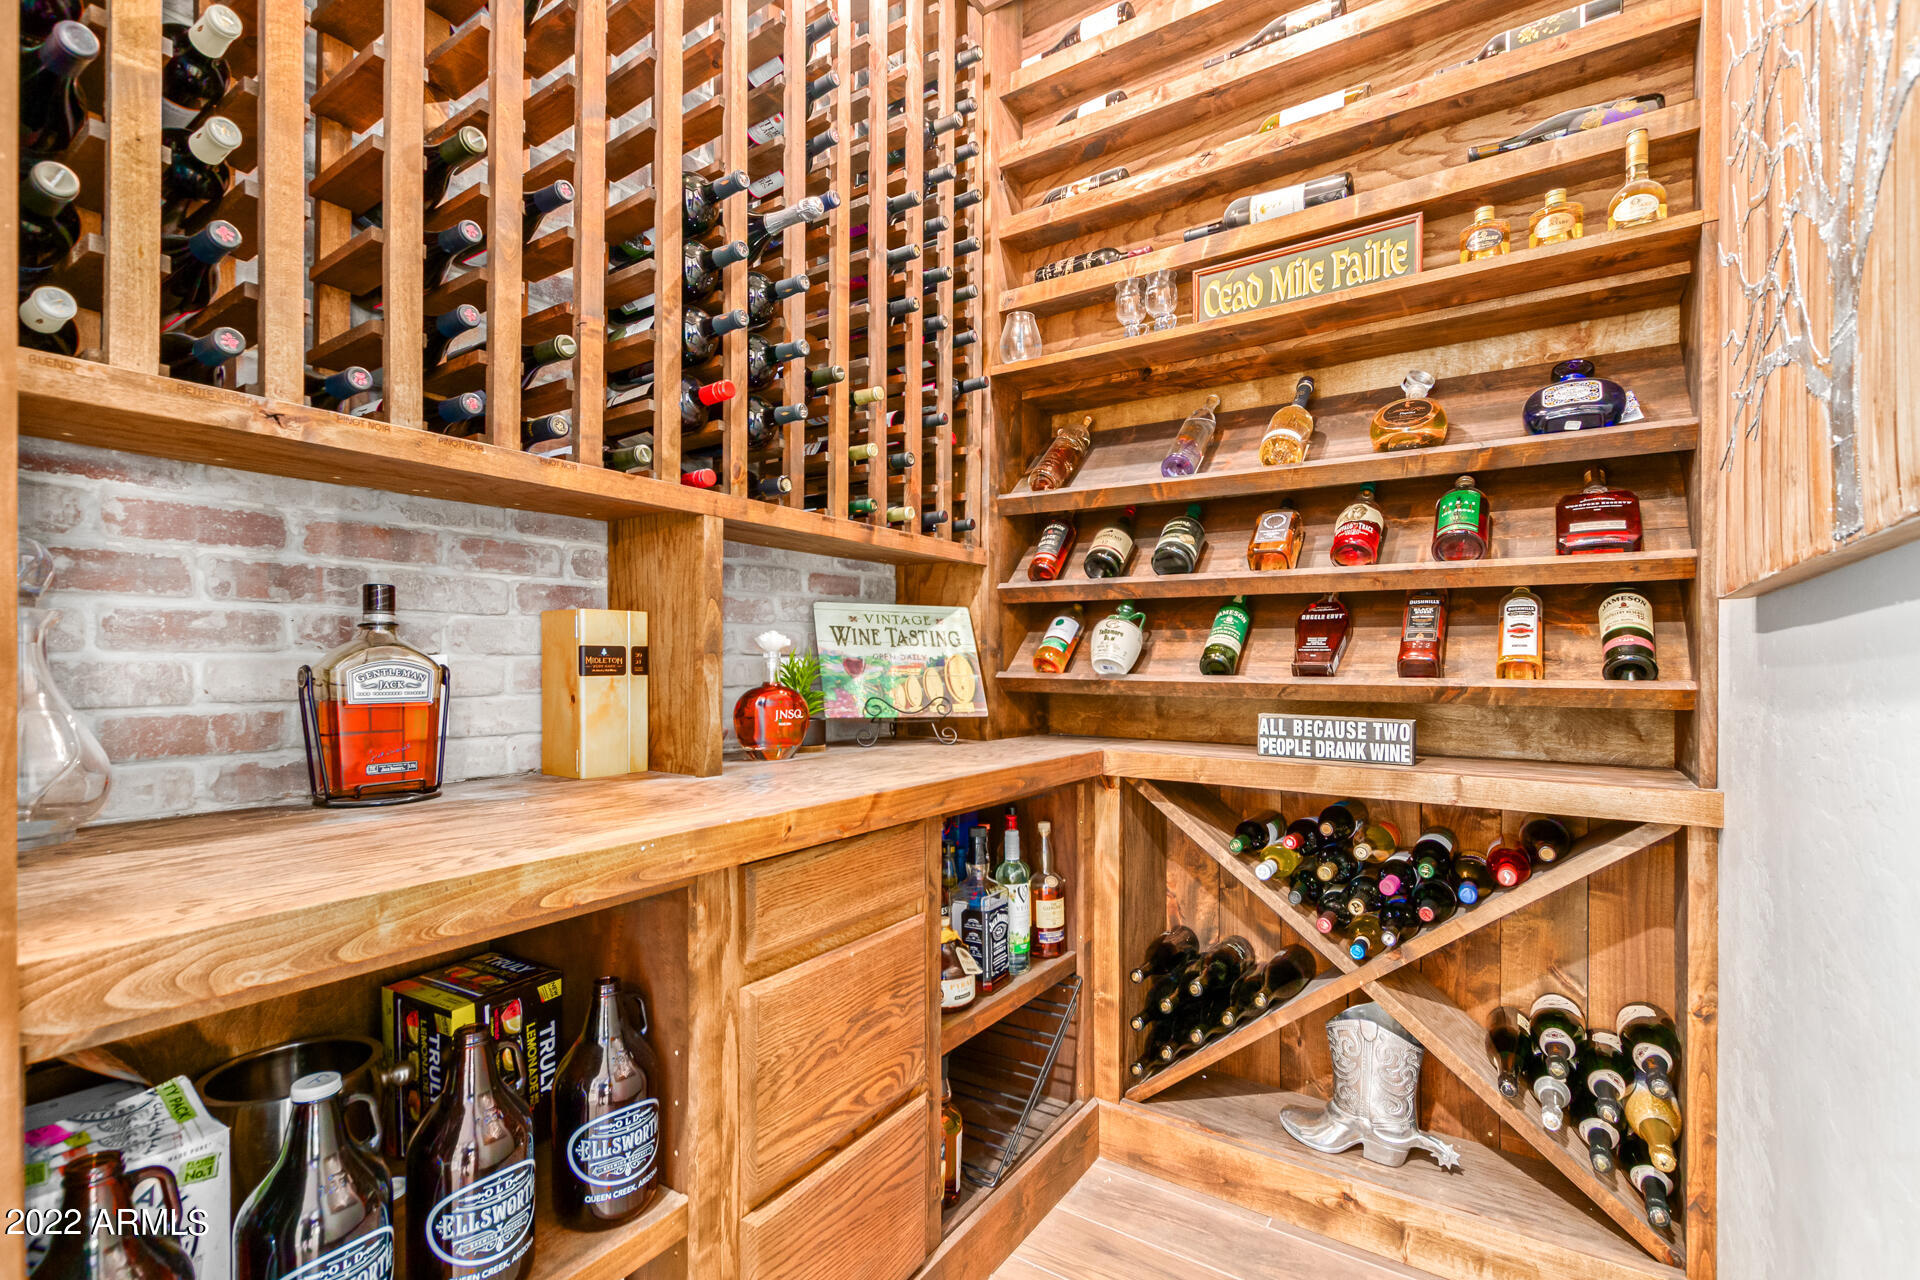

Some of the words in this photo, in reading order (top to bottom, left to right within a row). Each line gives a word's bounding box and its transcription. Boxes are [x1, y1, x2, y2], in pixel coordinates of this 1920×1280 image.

[1203, 268, 1264, 318] Céad
[1269, 257, 1325, 303] Mile
[28, 354, 74, 371] BLEND
[336, 415, 365, 428] PINOT
[367, 422, 391, 433] NOIR
[438, 436, 462, 449] PINOT
[463, 442, 485, 453] NOIR
[1602, 595, 1647, 611] JAMESON
[863, 614, 932, 626] VINTAGE
[829, 625, 881, 647] WINE
[885, 627, 962, 648] TASTING
[585, 656, 623, 665] MIDLETON
[355, 667, 427, 683] GENTLEMAN
[378, 680, 406, 690] JACK
[774, 708, 804, 722] JNSQ
[1259, 718, 1287, 736] ALL
[1293, 719, 1367, 740] BECAUSE
[1373, 722, 1411, 742] TWO
[1259, 737, 1312, 757] PEOPLE
[1315, 739, 1367, 760] DRANK
[1370, 743, 1411, 763] WINE
[485, 956, 537, 973] TRULY
[526, 1021, 539, 1095] LEMONADE
[539, 1020, 557, 1093] TRULY
[169, 1096, 192, 1120] PACK
[615, 1114, 640, 1129] OLD
[484, 1179, 513, 1197] OLD
[584, 1192, 612, 1203] QUEEN
[328, 1251, 364, 1275] OLD
